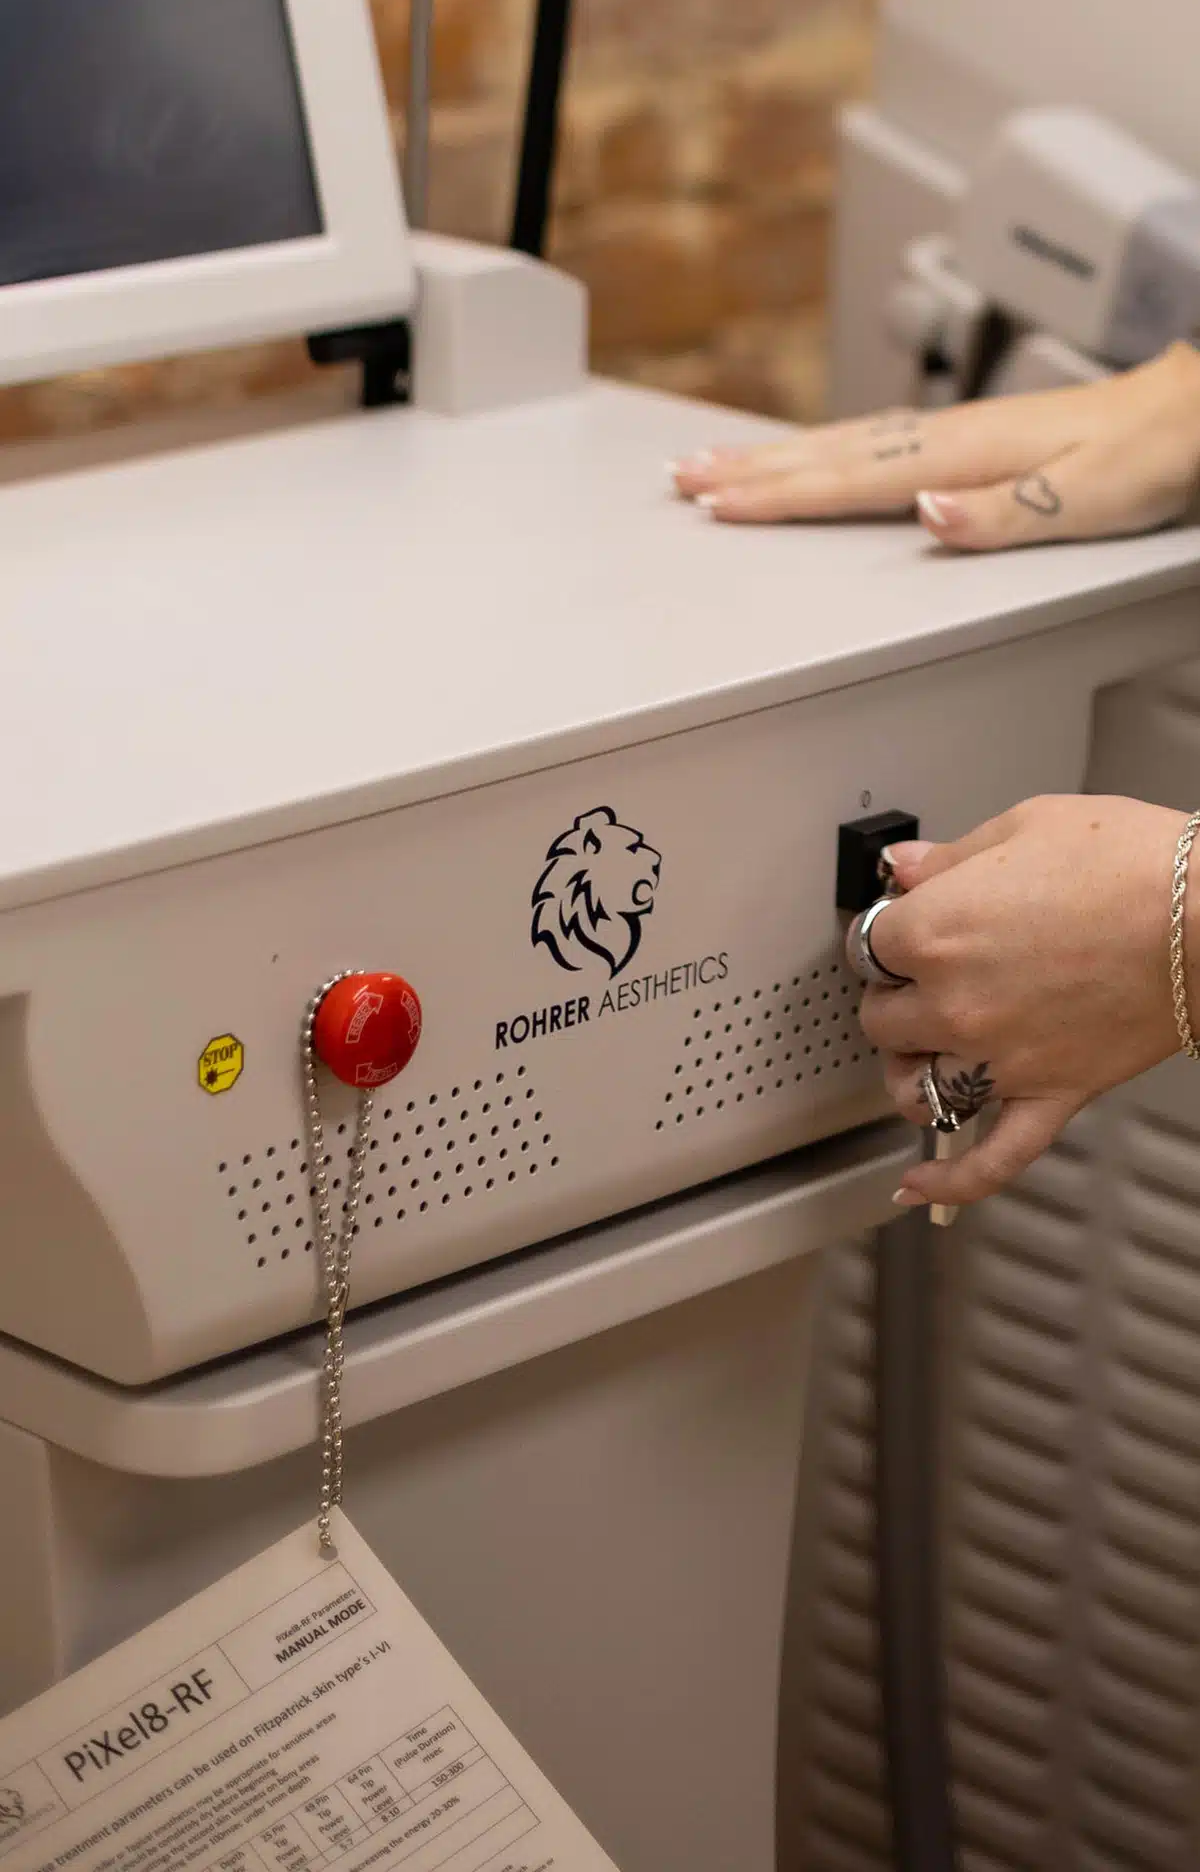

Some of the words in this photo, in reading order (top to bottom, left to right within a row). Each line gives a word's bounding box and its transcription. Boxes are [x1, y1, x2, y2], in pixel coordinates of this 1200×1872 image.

[495, 996, 590, 1050] ROHRER
[598, 952, 729, 1017] AESTHETICS
[203, 1043, 238, 1066] STOP
[311, 1589, 356, 1620] Parameters
[276, 1625, 329, 1663] MANUAL
[327, 1599, 366, 1628] MODE
[64, 1669, 212, 1782] PiXel8-RF
[406, 1728, 427, 1742] Time
[55, 1826, 111, 1866] treatment
[111, 1787, 174, 1832] parameters
[175, 1774, 195, 1789] can
[193, 1764, 211, 1776] be
[210, 1743, 238, 1766] used
[239, 1734, 255, 1747] on
[253, 1695, 312, 1736] Fitzpatrick
[312, 1681, 336, 1699] skin
[335, 1657, 370, 1682] type's
[369, 1641, 391, 1659] I-VI
[212, 1788, 224, 1797] be
[225, 1759, 269, 1790] appropriate
[268, 1750, 280, 1760] for
[281, 1728, 315, 1752] sensitive
[316, 1713, 336, 1730] areas
[394, 1749, 419, 1768] (Pulse
[418, 1722, 456, 1751] Duration)
[423, 1747, 444, 1763] msec
[230, 1789, 267, 1816] thickness
[266, 1783, 279, 1793] on
[276, 1769, 298, 1785] bony
[298, 1755, 319, 1772] areas
[347, 1773, 359, 1784] 64
[358, 1766, 373, 1776] Pin
[360, 1780, 374, 1791] Tip
[431, 1762, 464, 1787] 150-300
[212, 1793, 239, 1812] before
[237, 1768, 278, 1796] beginning
[244, 1805, 266, 1824] under
[287, 1776, 311, 1794] depth
[315, 1795, 329, 1806] Pin
[362, 1785, 387, 1805] Power
[316, 1809, 331, 1820] Tip
[372, 1796, 394, 1813] Level
[381, 1806, 400, 1823] 8-10
[272, 1824, 287, 1836] Pin
[318, 1816, 344, 1834] Power
[389, 1837, 404, 1848] the
[404, 1817, 431, 1838] energy
[430, 1796, 460, 1820] 20-30%
